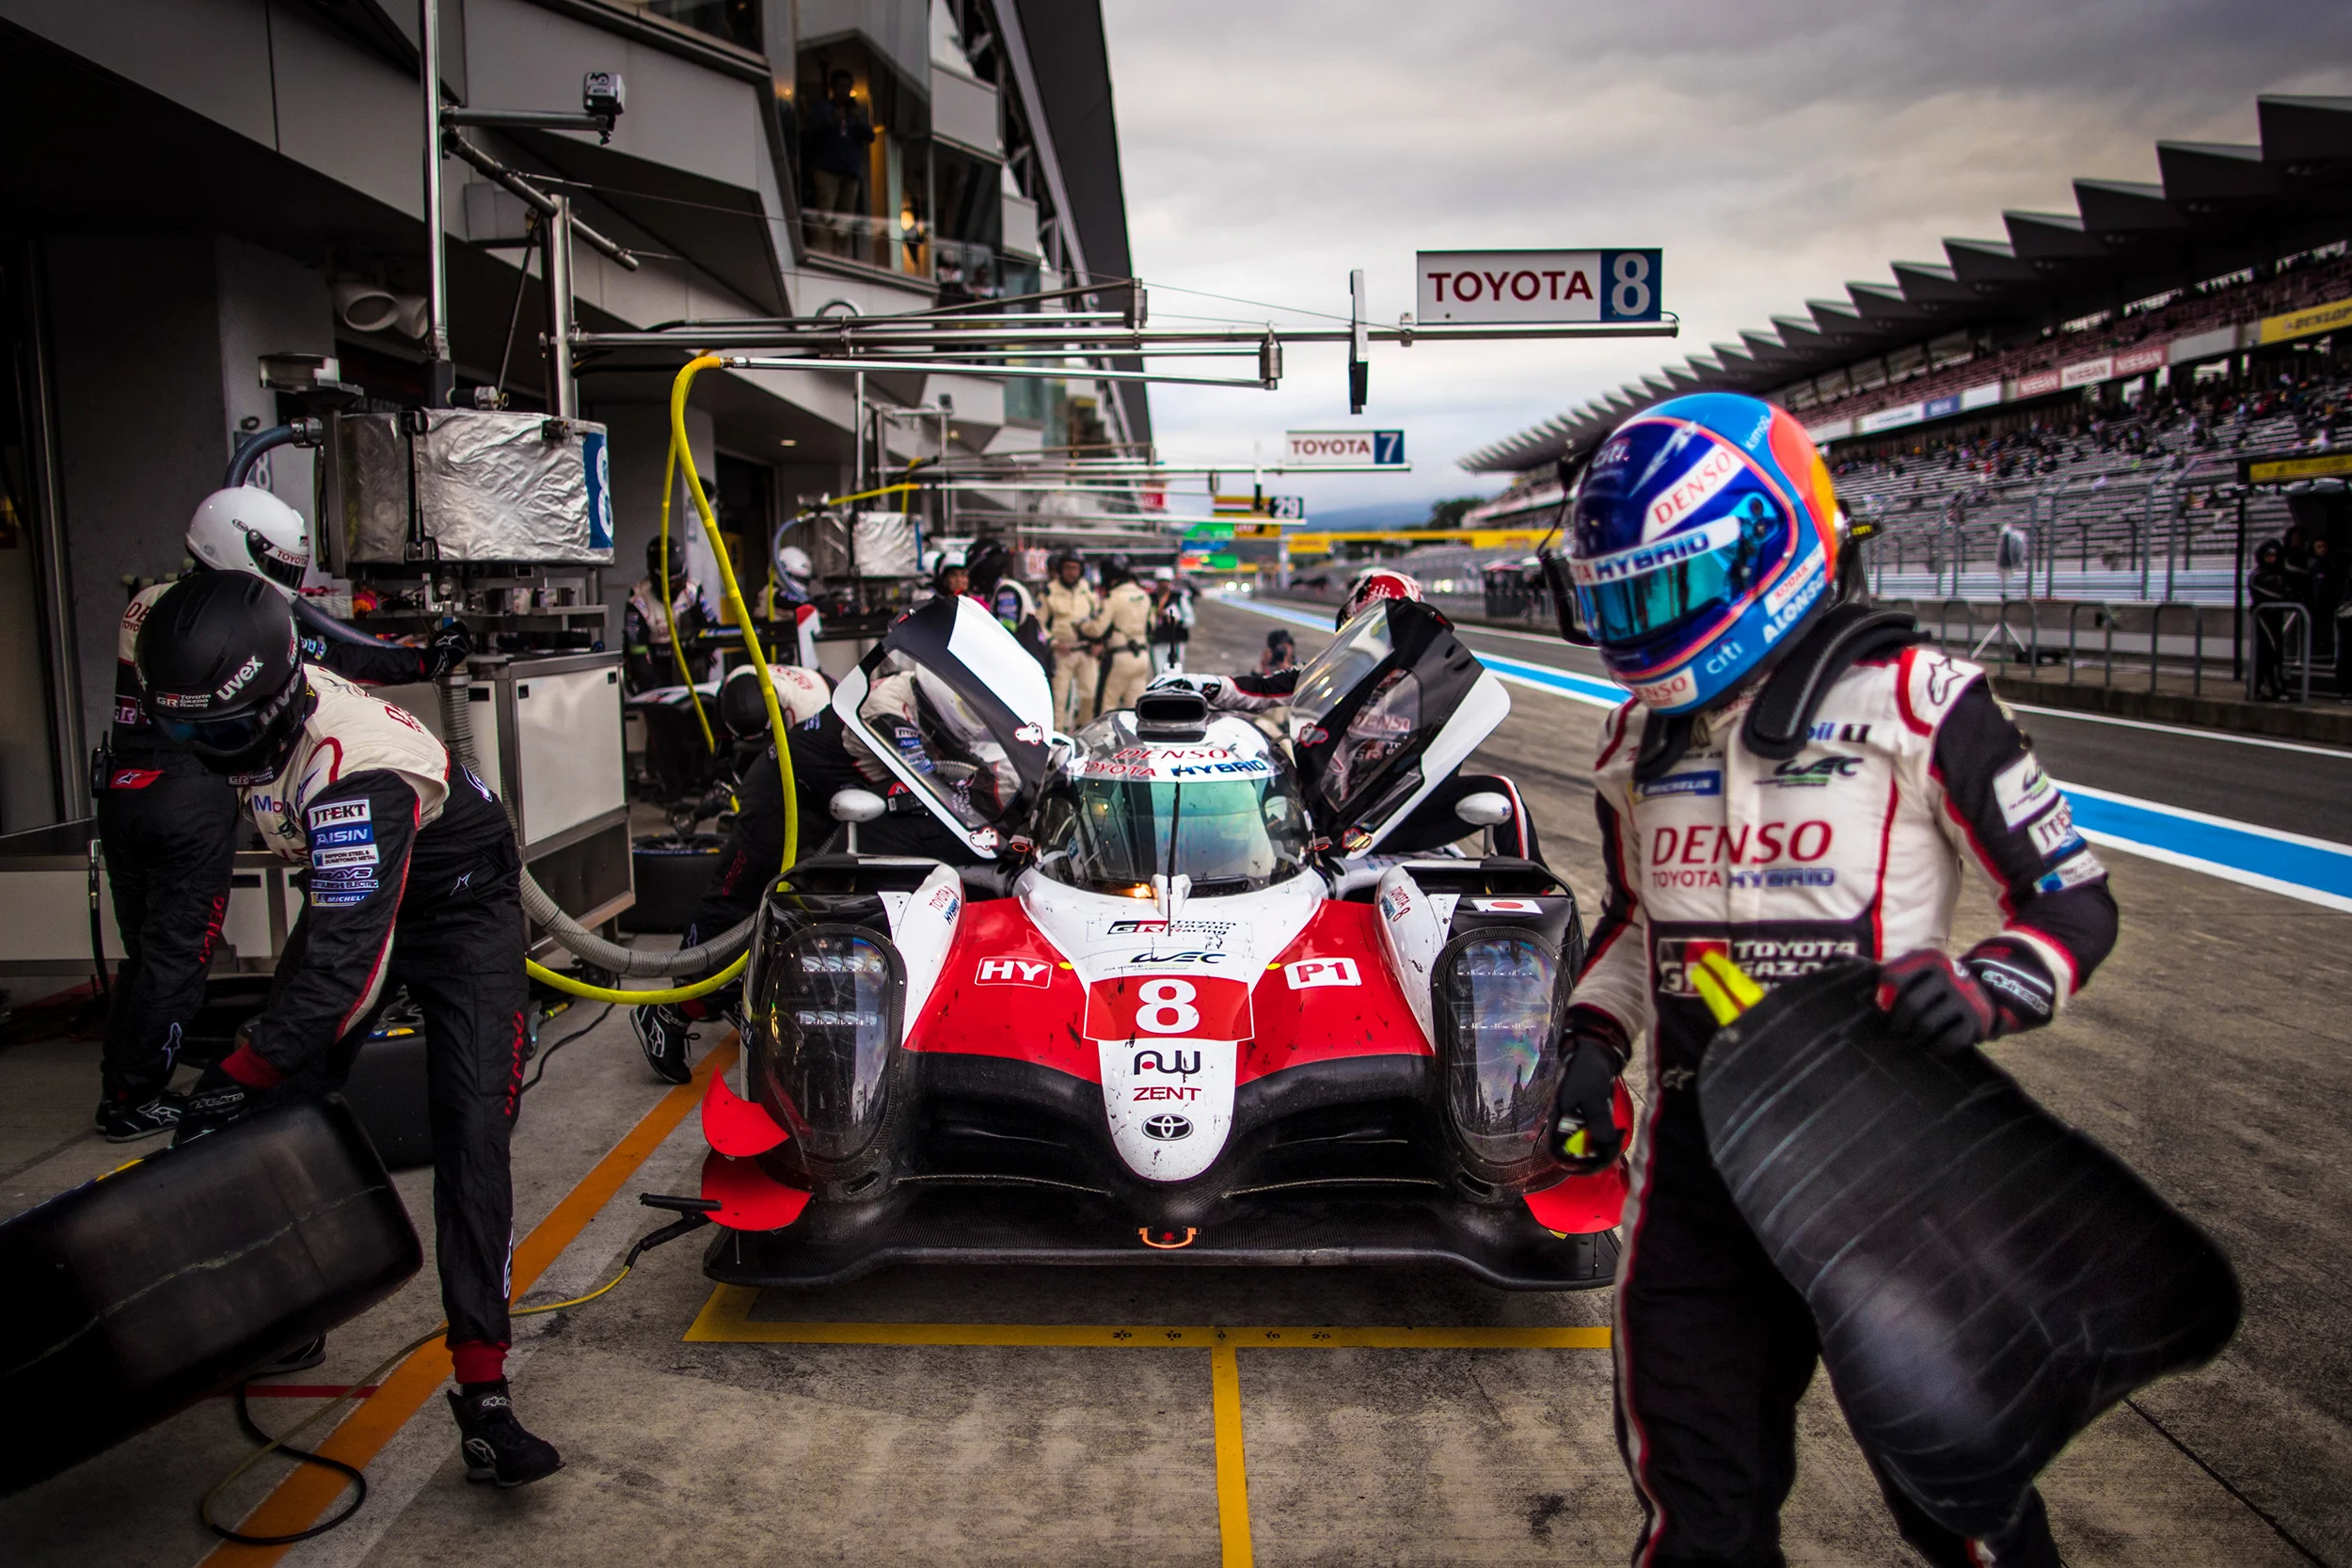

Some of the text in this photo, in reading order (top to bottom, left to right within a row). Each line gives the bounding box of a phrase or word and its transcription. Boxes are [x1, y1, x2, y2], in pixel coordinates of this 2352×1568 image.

[1427, 252, 1650, 316] TOYOTA 8
[1292, 433, 1400, 462] TOYOTA 7
[1654, 451, 1732, 525] DENSO
[1274, 498, 1300, 518] 29
[1595, 531, 1709, 580] HYBRID
[1763, 570, 1826, 643] ALONSO
[121, 620, 139, 632] TOYO
[1706, 640, 1743, 674] citi
[216, 656, 264, 702] uvex
[157, 696, 179, 707] GR
[1113, 748, 1229, 760] DENSO
[1083, 758, 1268, 777] TOYOTA HYBRID
[313, 803, 366, 827] JTEKT
[316, 829, 368, 846] AISIN
[1651, 819, 1833, 866] DENSO
[345, 879, 378, 888] ELECTRIC
[1652, 866, 1836, 888] TOYOTA HYBRID
[1392, 907, 1411, 923] 8
[1109, 922, 1167, 935] GR
[1130, 951, 1226, 964] WEC
[1735, 941, 1860, 958] TOYOTA
[980, 960, 1047, 981] HY
[1297, 961, 1351, 983] P1
[1136, 978, 1200, 1034] 8
[1133, 1087, 1201, 1101] ZENT
